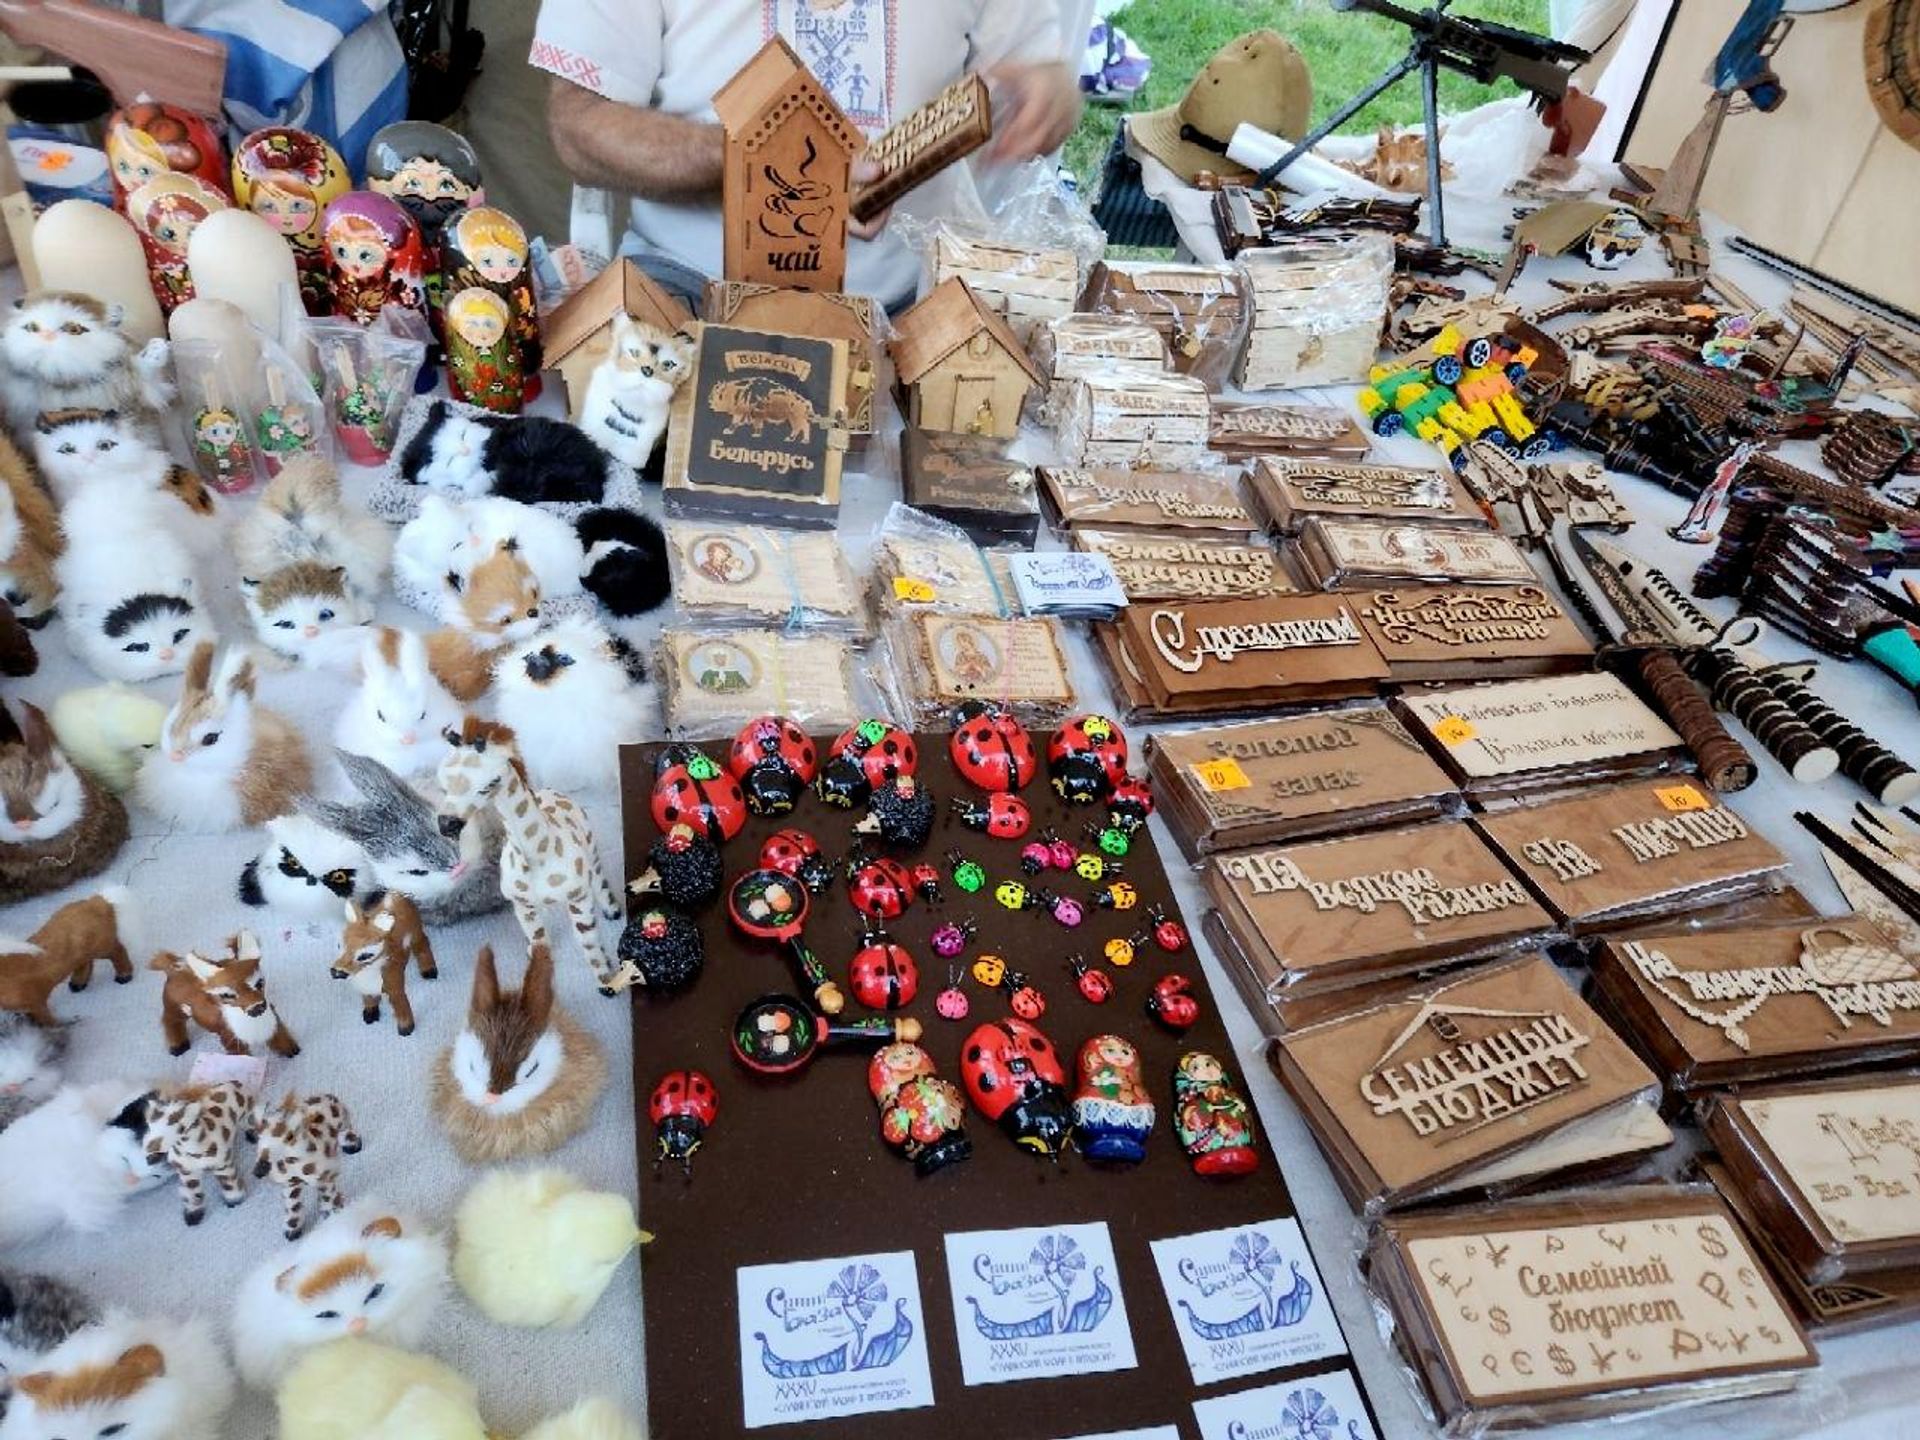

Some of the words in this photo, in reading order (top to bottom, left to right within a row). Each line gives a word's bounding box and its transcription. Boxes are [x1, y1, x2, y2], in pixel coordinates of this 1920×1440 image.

[767, 244, 822, 273] чай
[708, 439, 815, 475] Беларусь
[1362, 602, 1417, 625] На
[1420, 601, 1562, 631] красивую
[1461, 621, 1552, 642] жизнь
[1151, 610, 1204, 672] С
[1529, 837, 1603, 882] На
[1622, 941, 1682, 983] На
[1400, 1052, 1589, 1136] БЮДЖЕТ
[1518, 1254, 1674, 1298] Семейный
[1548, 1299, 1684, 1340] бюджет
